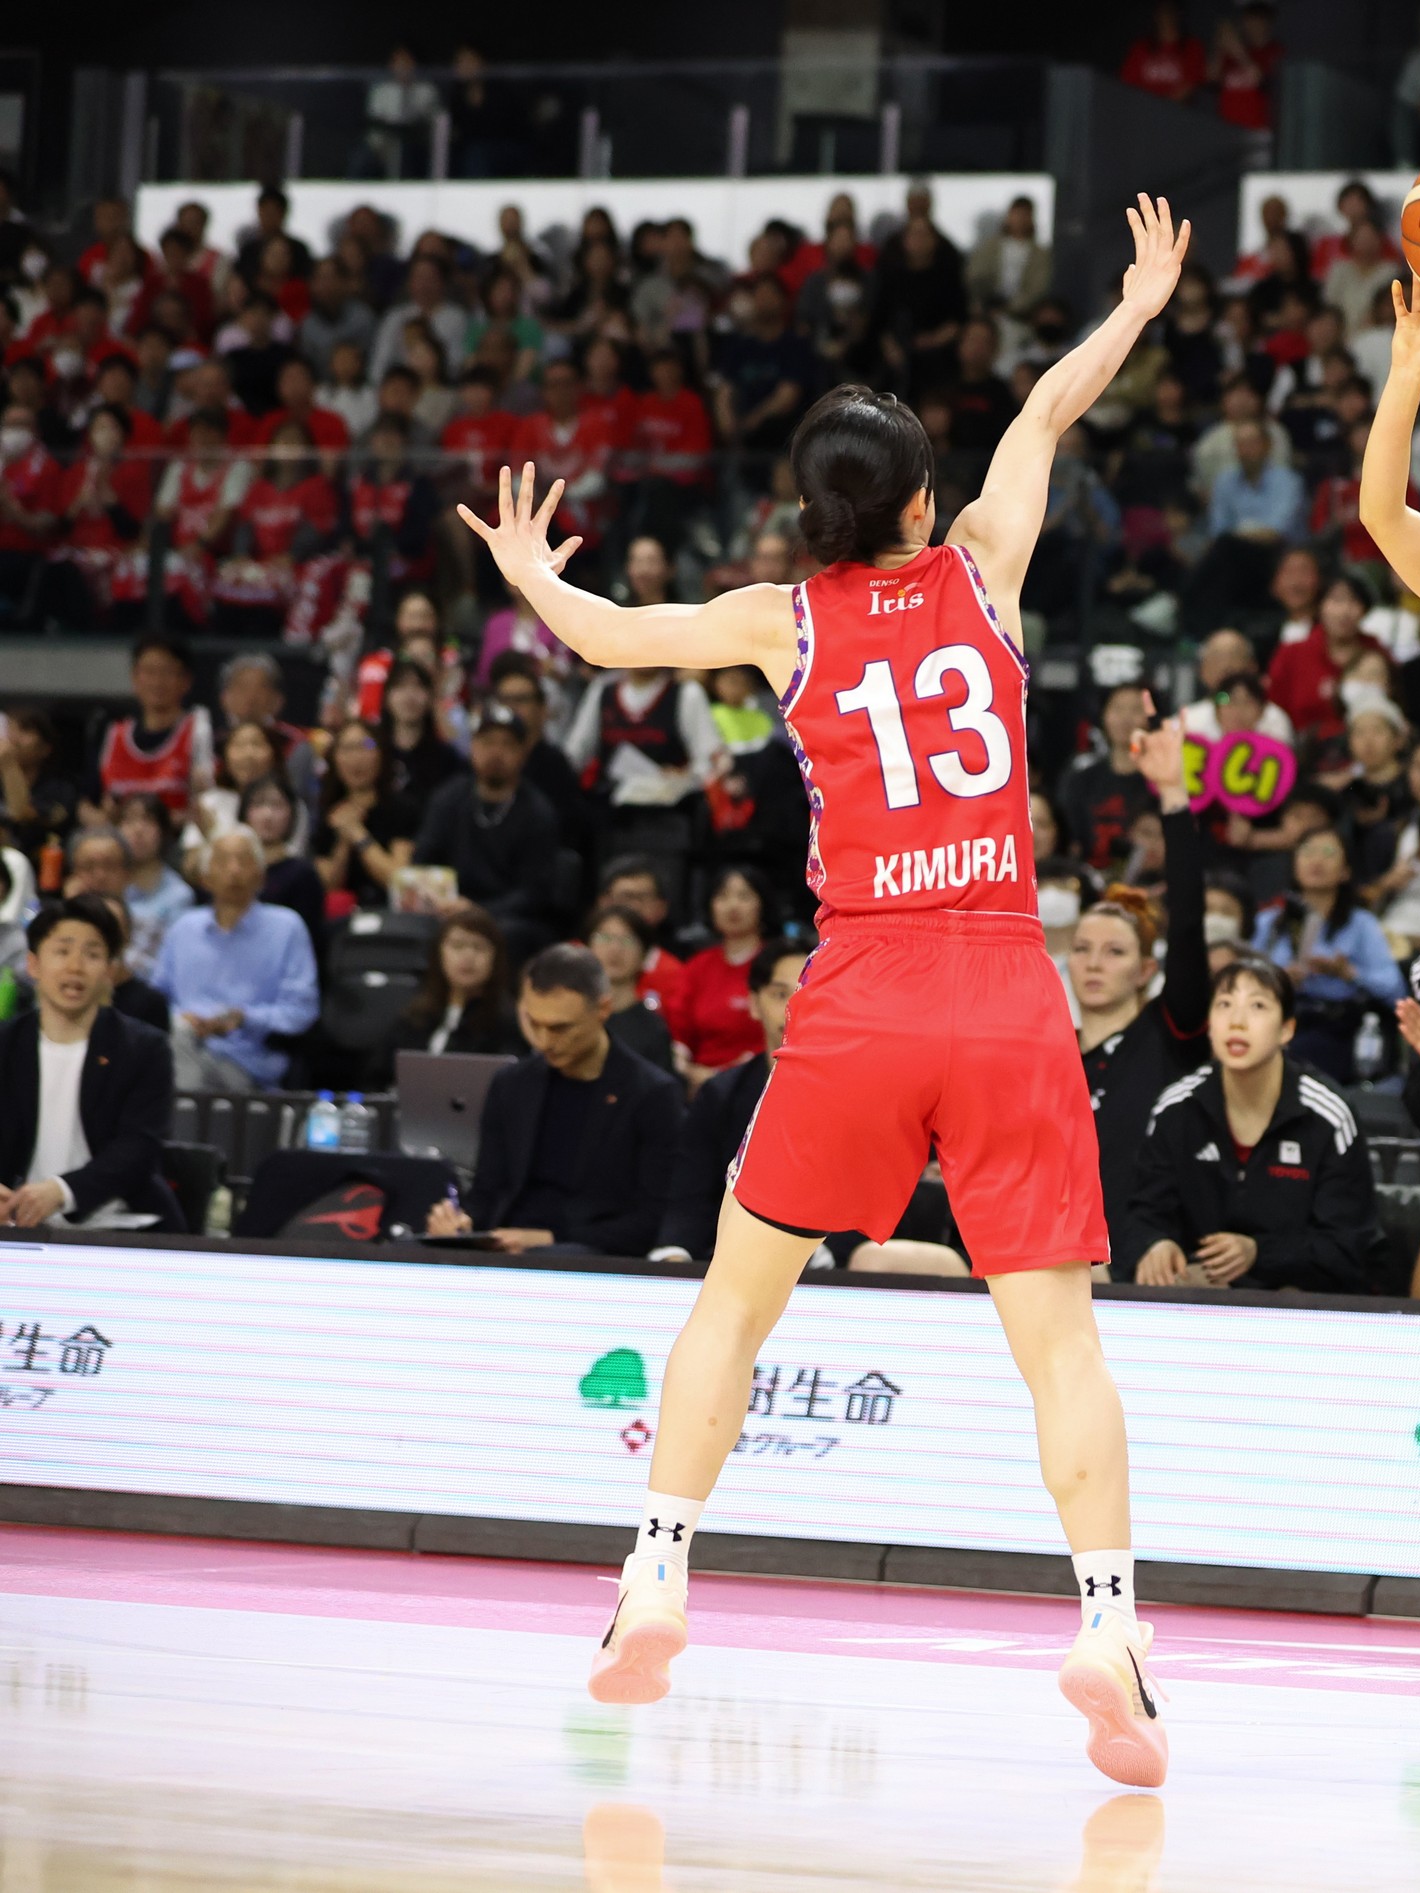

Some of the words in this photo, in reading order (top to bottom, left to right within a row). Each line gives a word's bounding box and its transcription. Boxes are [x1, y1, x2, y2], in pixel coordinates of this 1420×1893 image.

[867, 588, 925, 616] Iris
[869, 578, 900, 587] DENSO
[834, 643, 1012, 811] 13
[873, 834, 1018, 899] KIMURA
[0, 1322, 113, 1377] 生命
[750, 1364, 904, 1424] 生命
